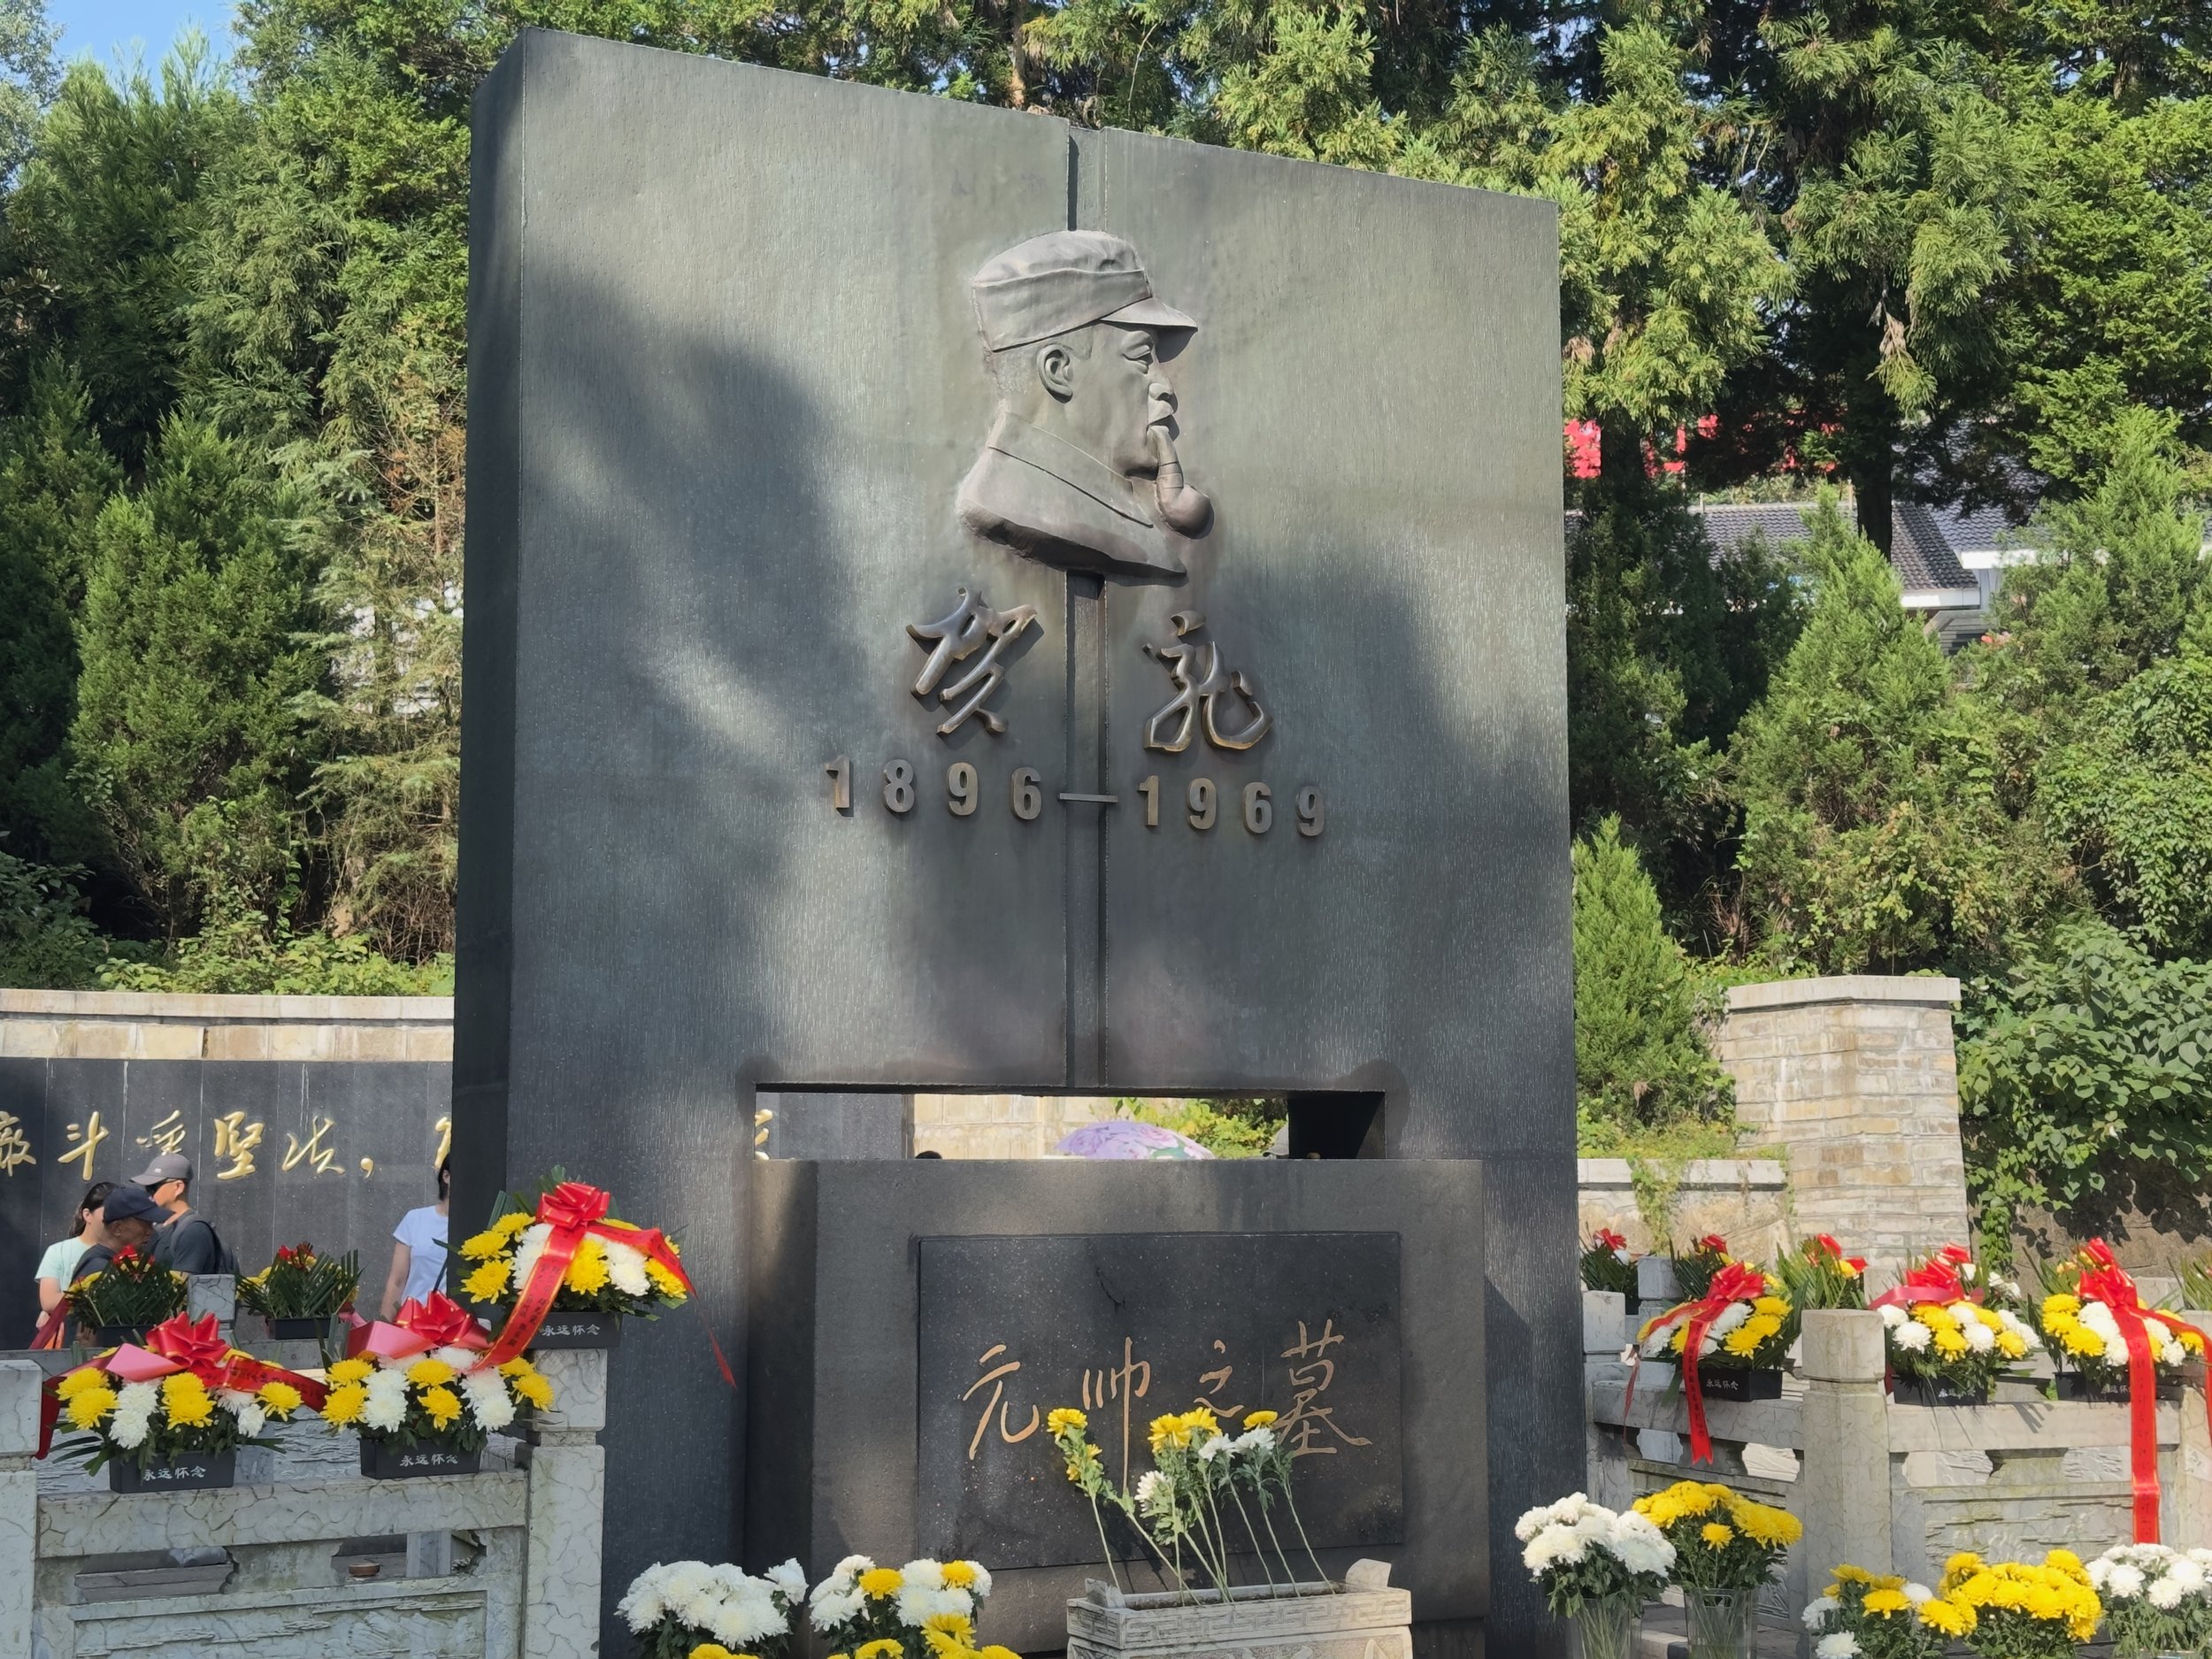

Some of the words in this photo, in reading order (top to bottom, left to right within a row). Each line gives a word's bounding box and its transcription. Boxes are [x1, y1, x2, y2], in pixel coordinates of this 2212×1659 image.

[541, 1324, 600, 1337] 永远怀念
[1706, 1378, 1739, 1391] 永远怀念
[962, 1318, 1372, 1493] 元帅之墓
[398, 1453, 458, 1467] 永远怀念
[142, 1465, 206, 1481] 永远怀念
